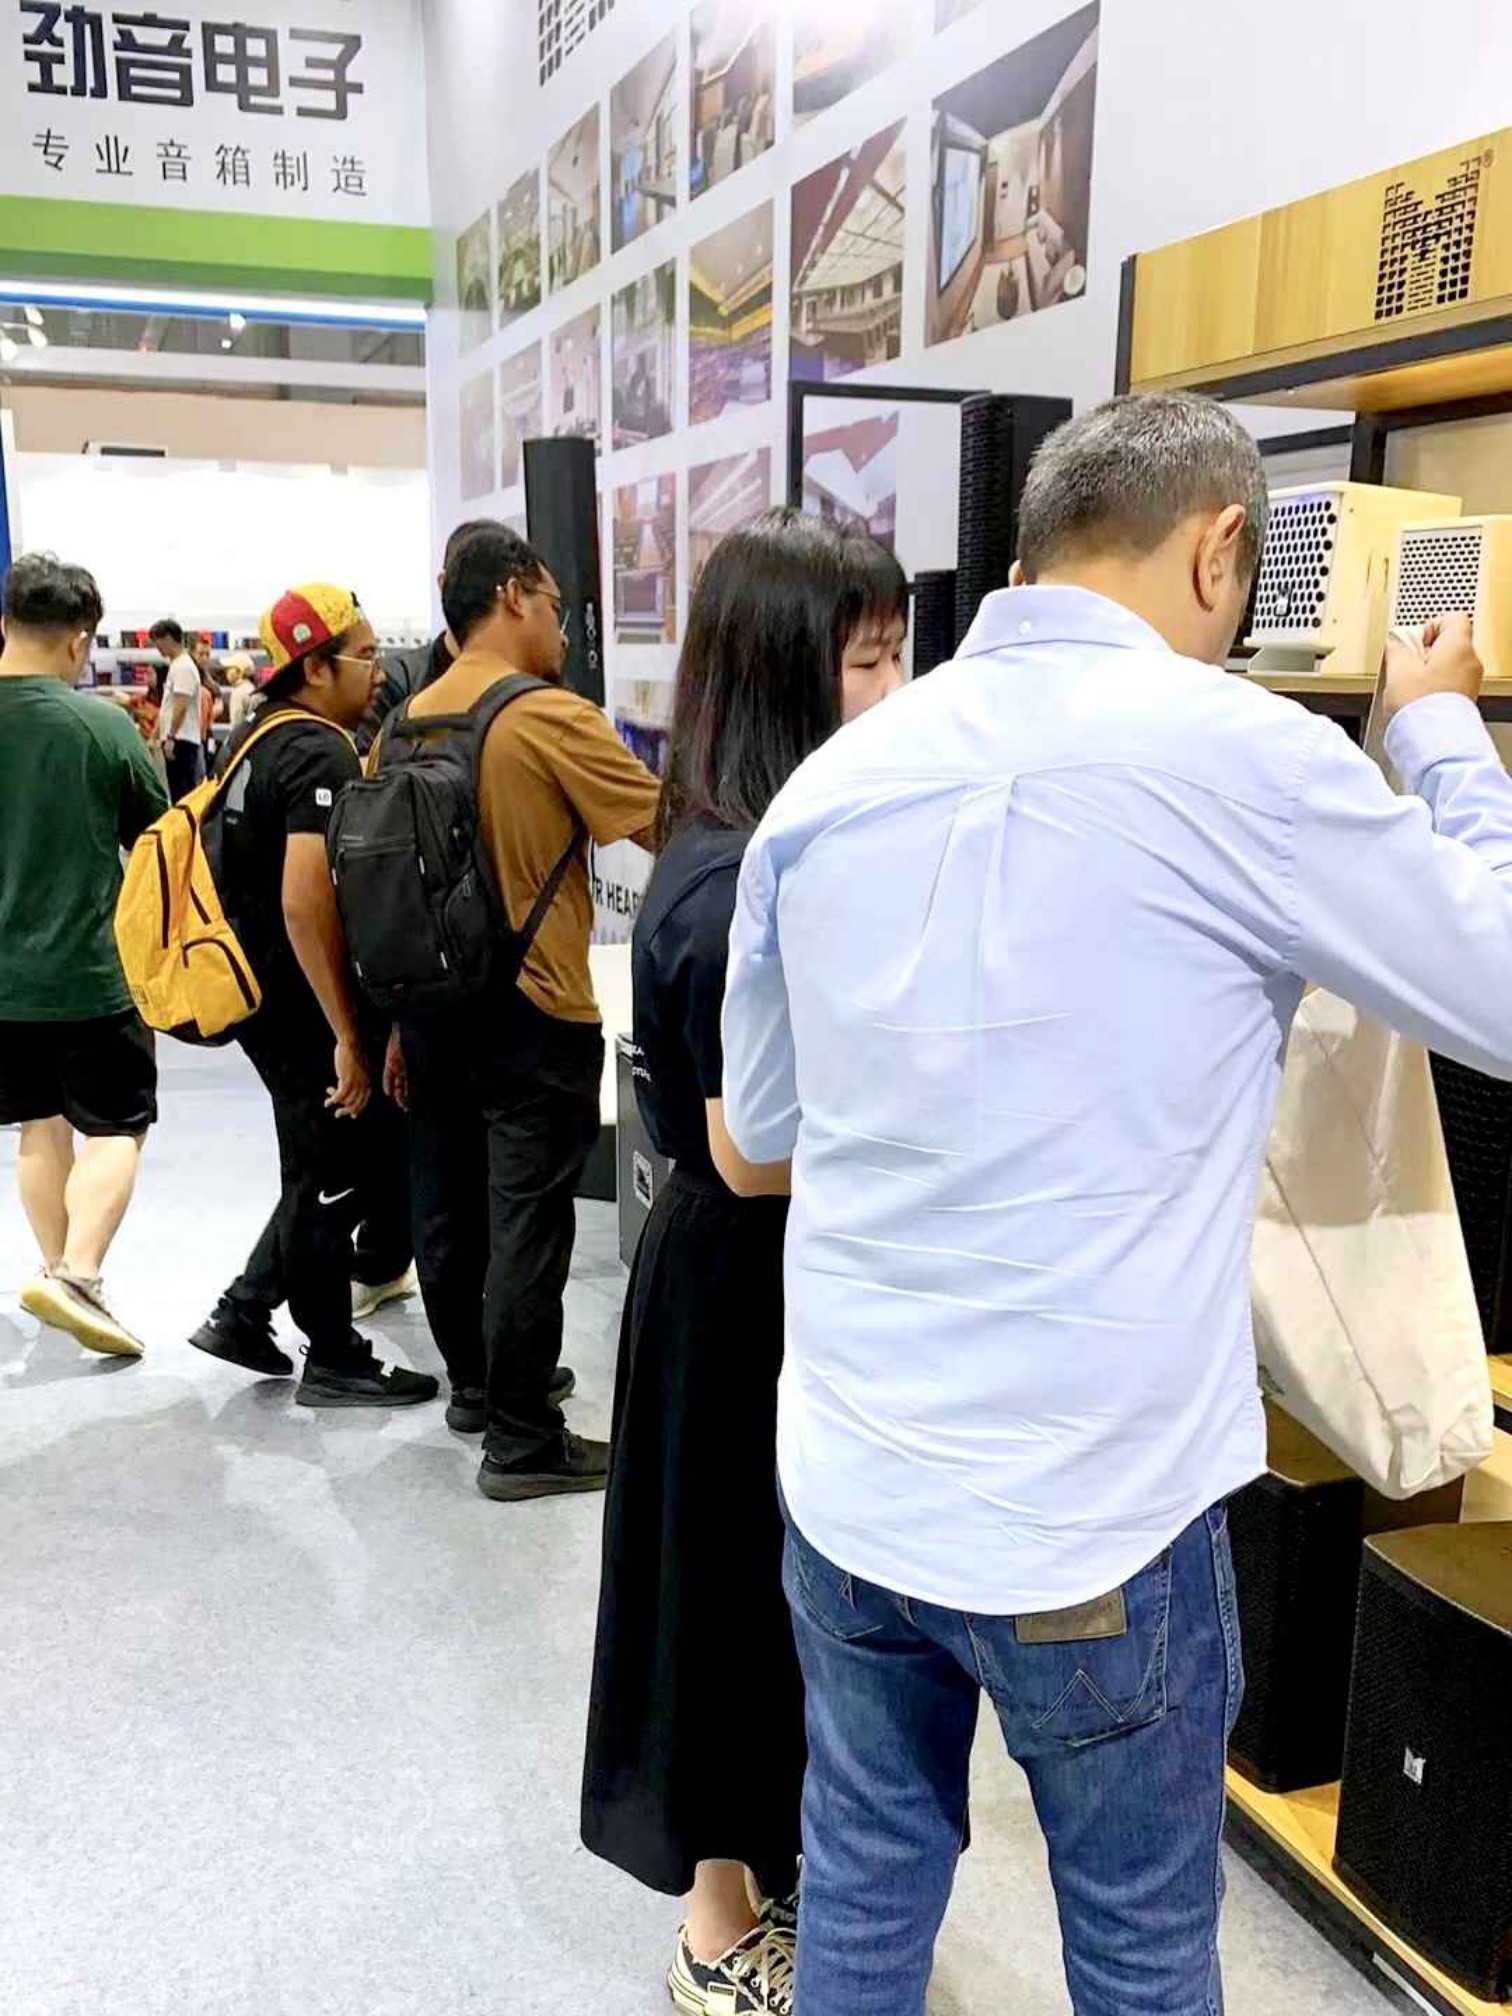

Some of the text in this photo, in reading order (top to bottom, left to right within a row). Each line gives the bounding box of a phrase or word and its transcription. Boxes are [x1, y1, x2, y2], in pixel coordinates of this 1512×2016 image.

[20, 0, 364, 120] 劲音电子
[32, 128, 367, 197] 专业音箱制造
